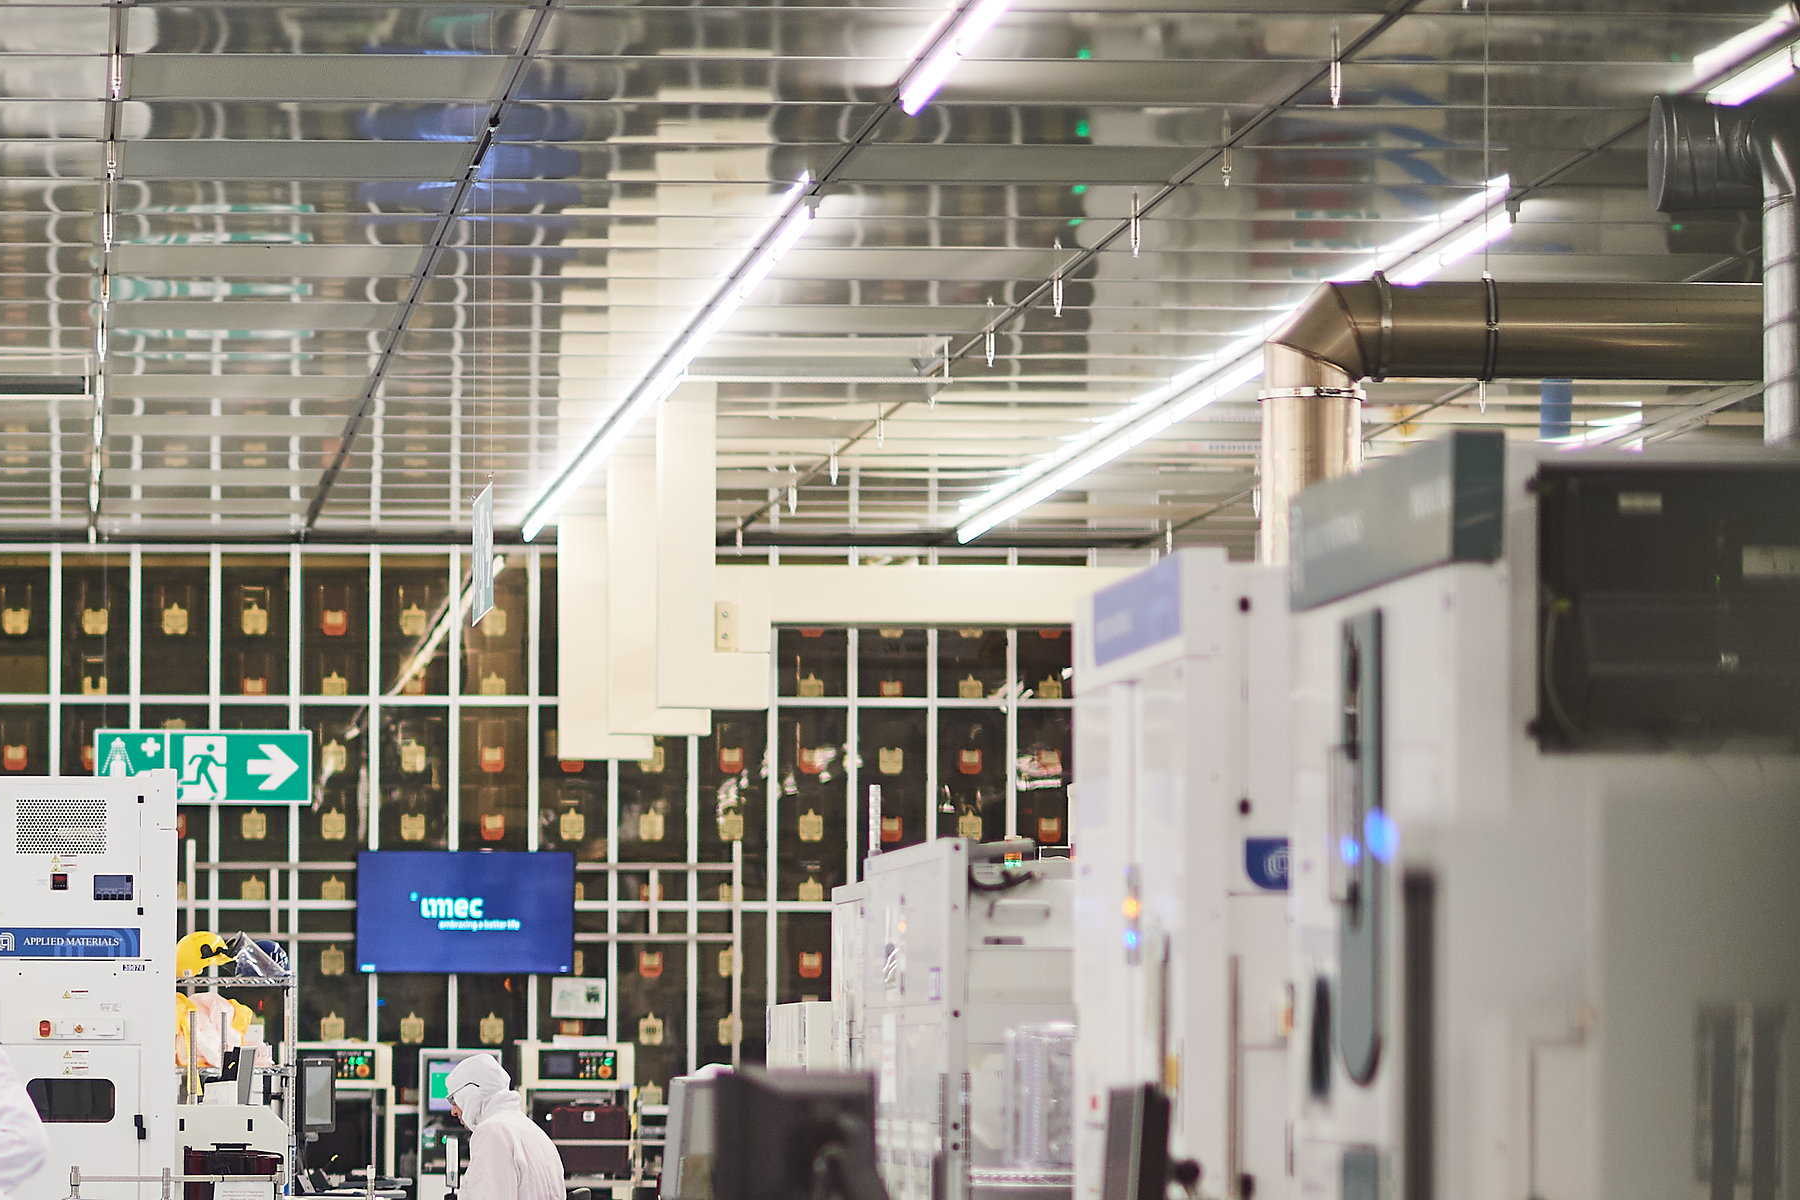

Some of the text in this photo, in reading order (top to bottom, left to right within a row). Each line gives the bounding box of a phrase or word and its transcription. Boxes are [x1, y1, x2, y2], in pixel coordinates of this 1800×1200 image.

[410, 891, 485, 919] imec
[438, 919, 478, 932] embracing
[484, 919, 507, 931] better
[507, 918, 521, 931] life
[23, 937, 120, 946] APPLIED MATERIALS
